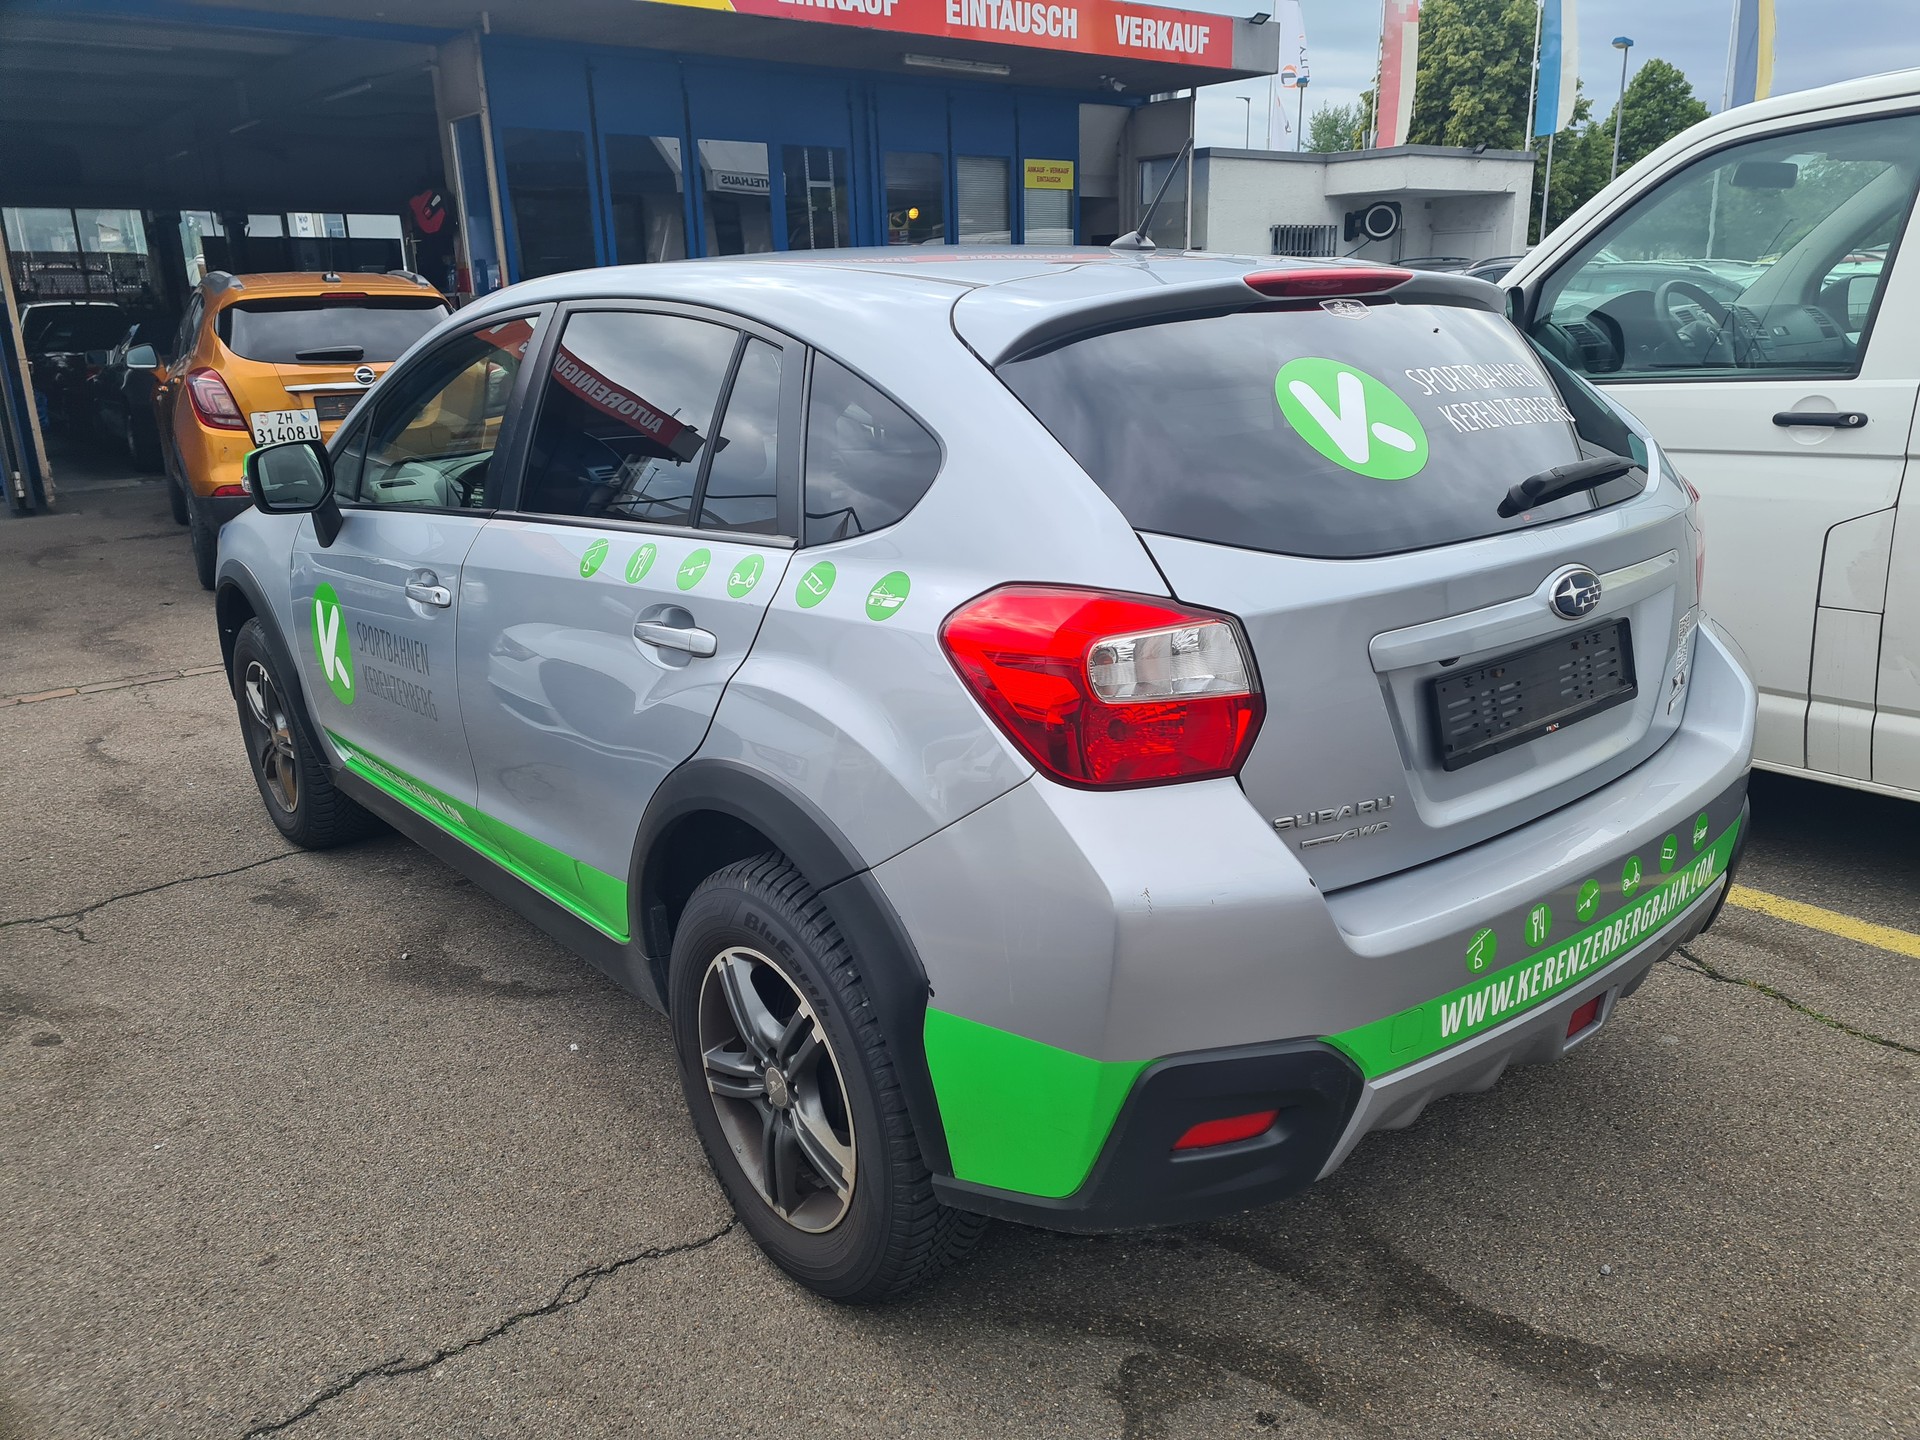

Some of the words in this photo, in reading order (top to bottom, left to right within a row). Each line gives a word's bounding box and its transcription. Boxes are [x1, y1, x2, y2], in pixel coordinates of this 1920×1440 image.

[946, 0, 1078, 39] EINTAUSCH
[1115, 14, 1210, 54] VERKAUF
[1405, 363, 1544, 396] SPORTBAHNEN
[276, 412, 293, 425] ZH
[1438, 396, 1576, 433] KERENZERBERG
[356, 621, 430, 676] SPORTBAHNEN
[361, 663, 438, 722] KERENZERBERG
[1272, 795, 1395, 831] SUBARU
[1337, 821, 1391, 843] AWD
[1441, 848, 1716, 1038] WWW.KERENZERBERGBAHN.COM
